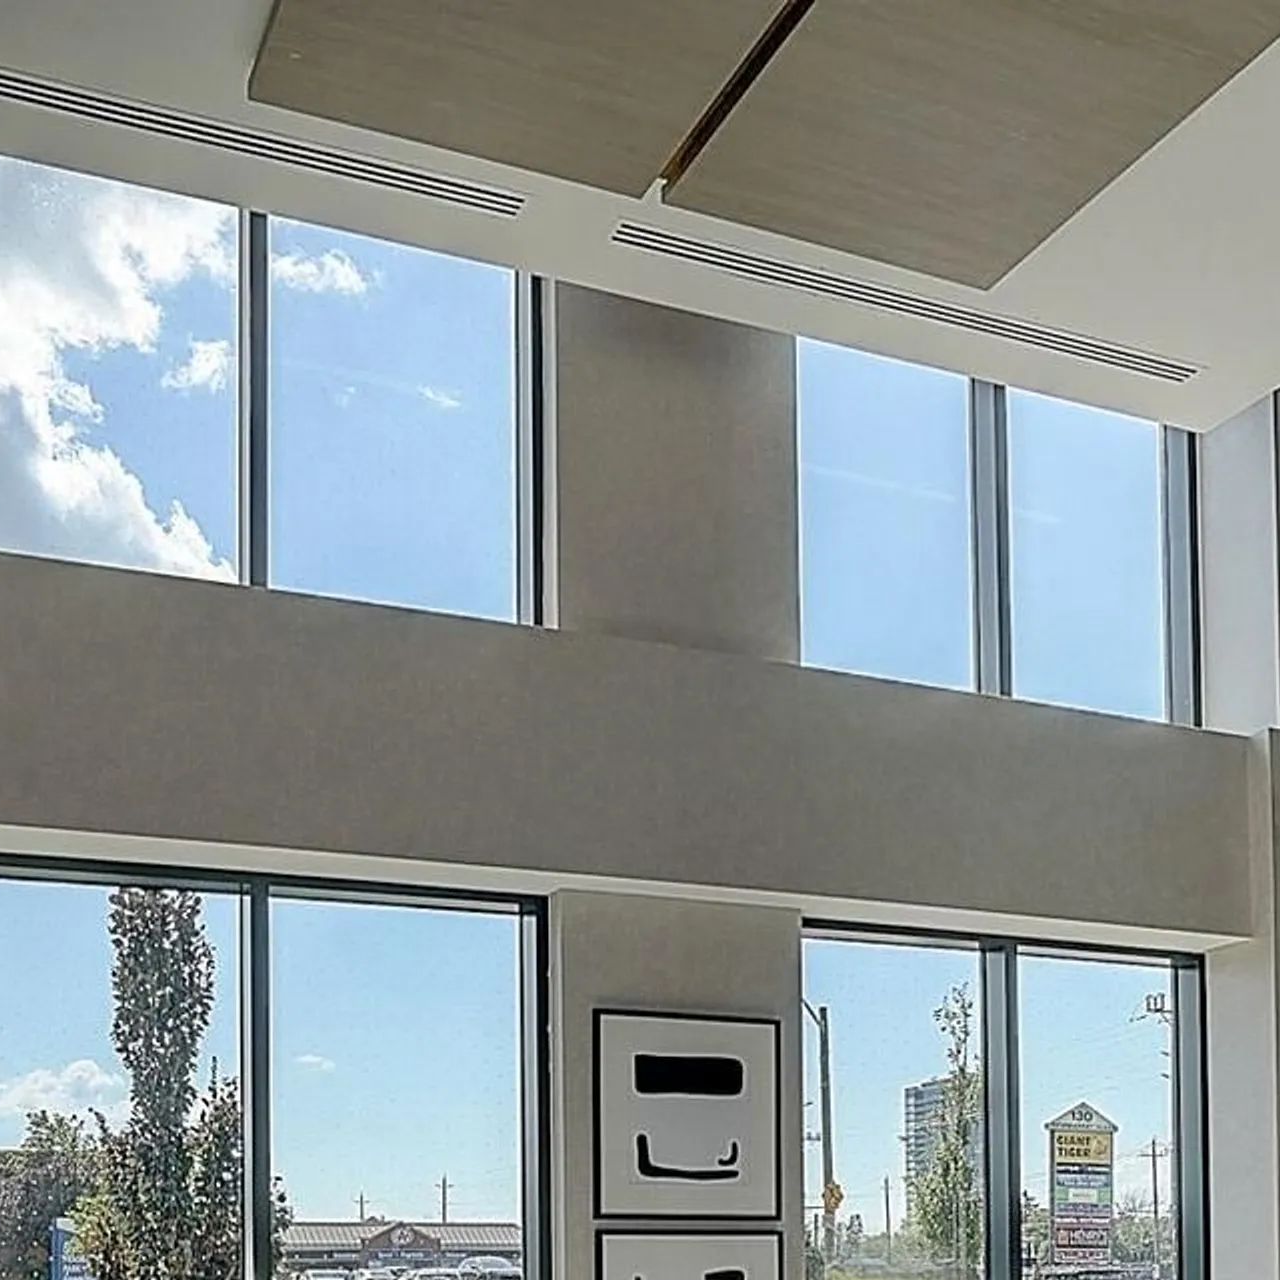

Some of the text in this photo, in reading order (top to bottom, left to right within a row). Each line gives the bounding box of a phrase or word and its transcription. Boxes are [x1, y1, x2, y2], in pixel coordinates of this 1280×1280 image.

[1071, 1110, 1093, 1122] 130
[1057, 1135, 1091, 1146] GIANT
[1057, 1147, 1091, 1157] TIGER
